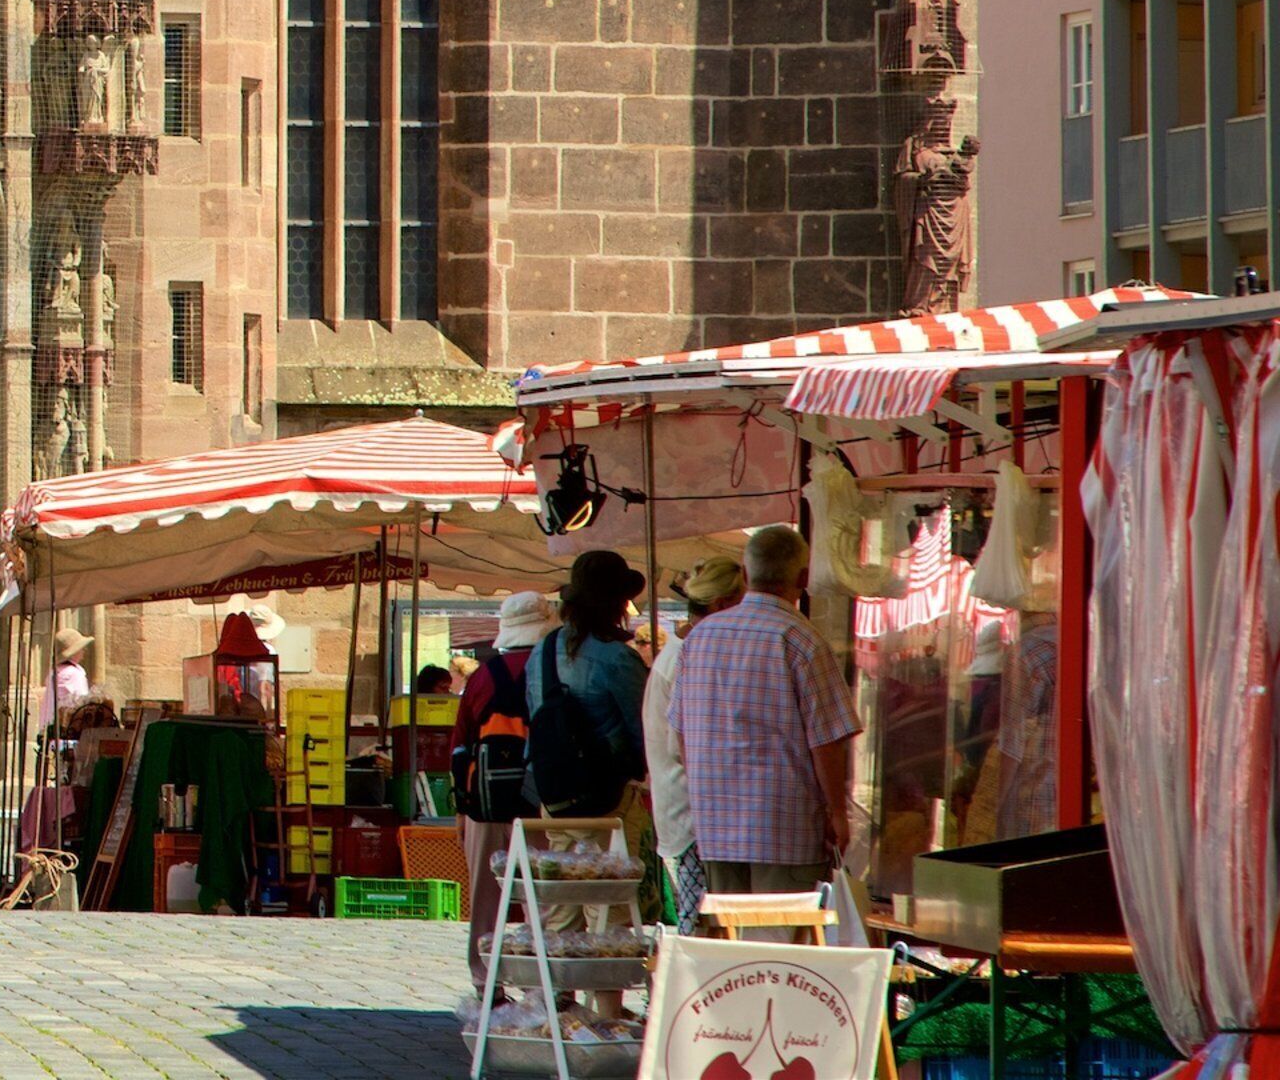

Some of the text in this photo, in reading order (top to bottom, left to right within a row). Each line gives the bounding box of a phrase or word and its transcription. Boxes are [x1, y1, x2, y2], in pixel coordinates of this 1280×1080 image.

[302, 572, 315, 584] &
[691, 970, 848, 1028] Friedrich's Kirschen
[693, 1024, 753, 1042] fränkisch
